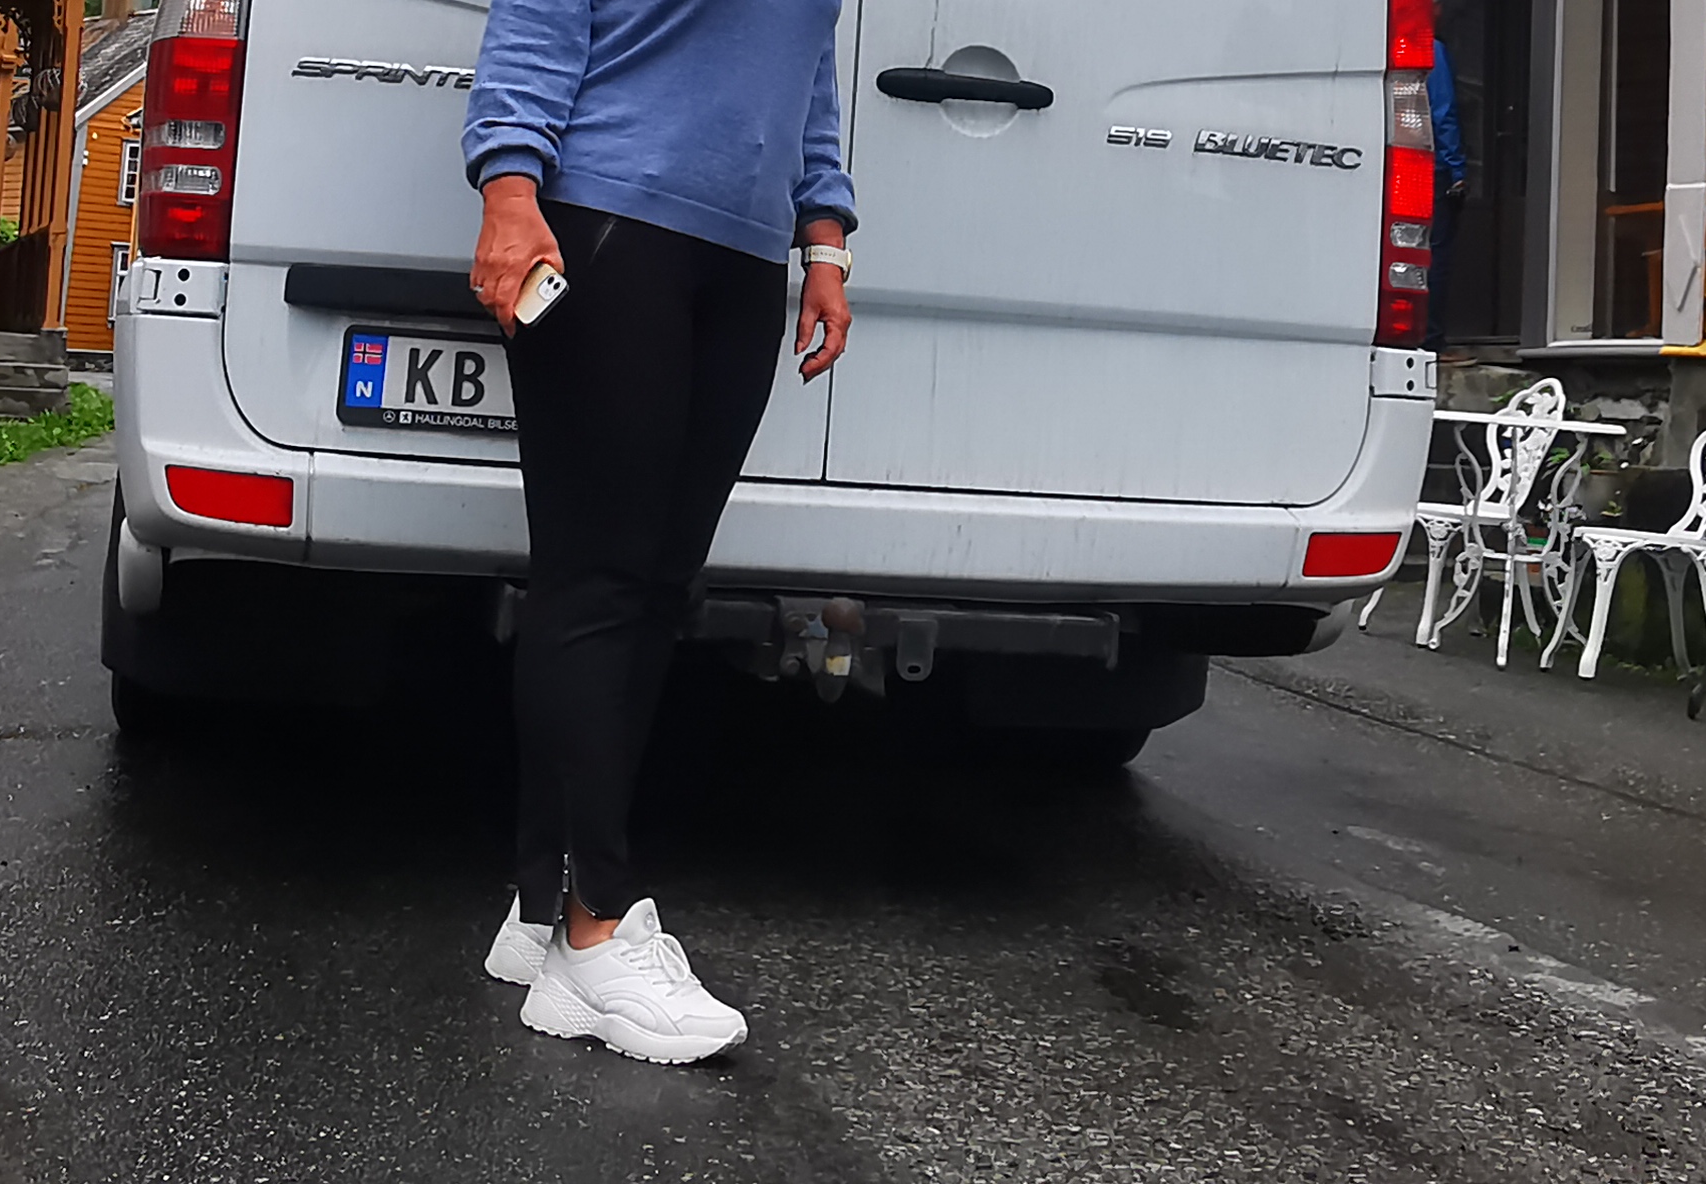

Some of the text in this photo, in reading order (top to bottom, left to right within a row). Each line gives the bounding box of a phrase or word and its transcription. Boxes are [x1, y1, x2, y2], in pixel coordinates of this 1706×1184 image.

[291, 57, 475, 90] SPRINTE
[1193, 128, 1363, 170] BLUETEC
[355, 380, 373, 398] N
[415, 414, 518, 431] HALLINGDAL BILSE
